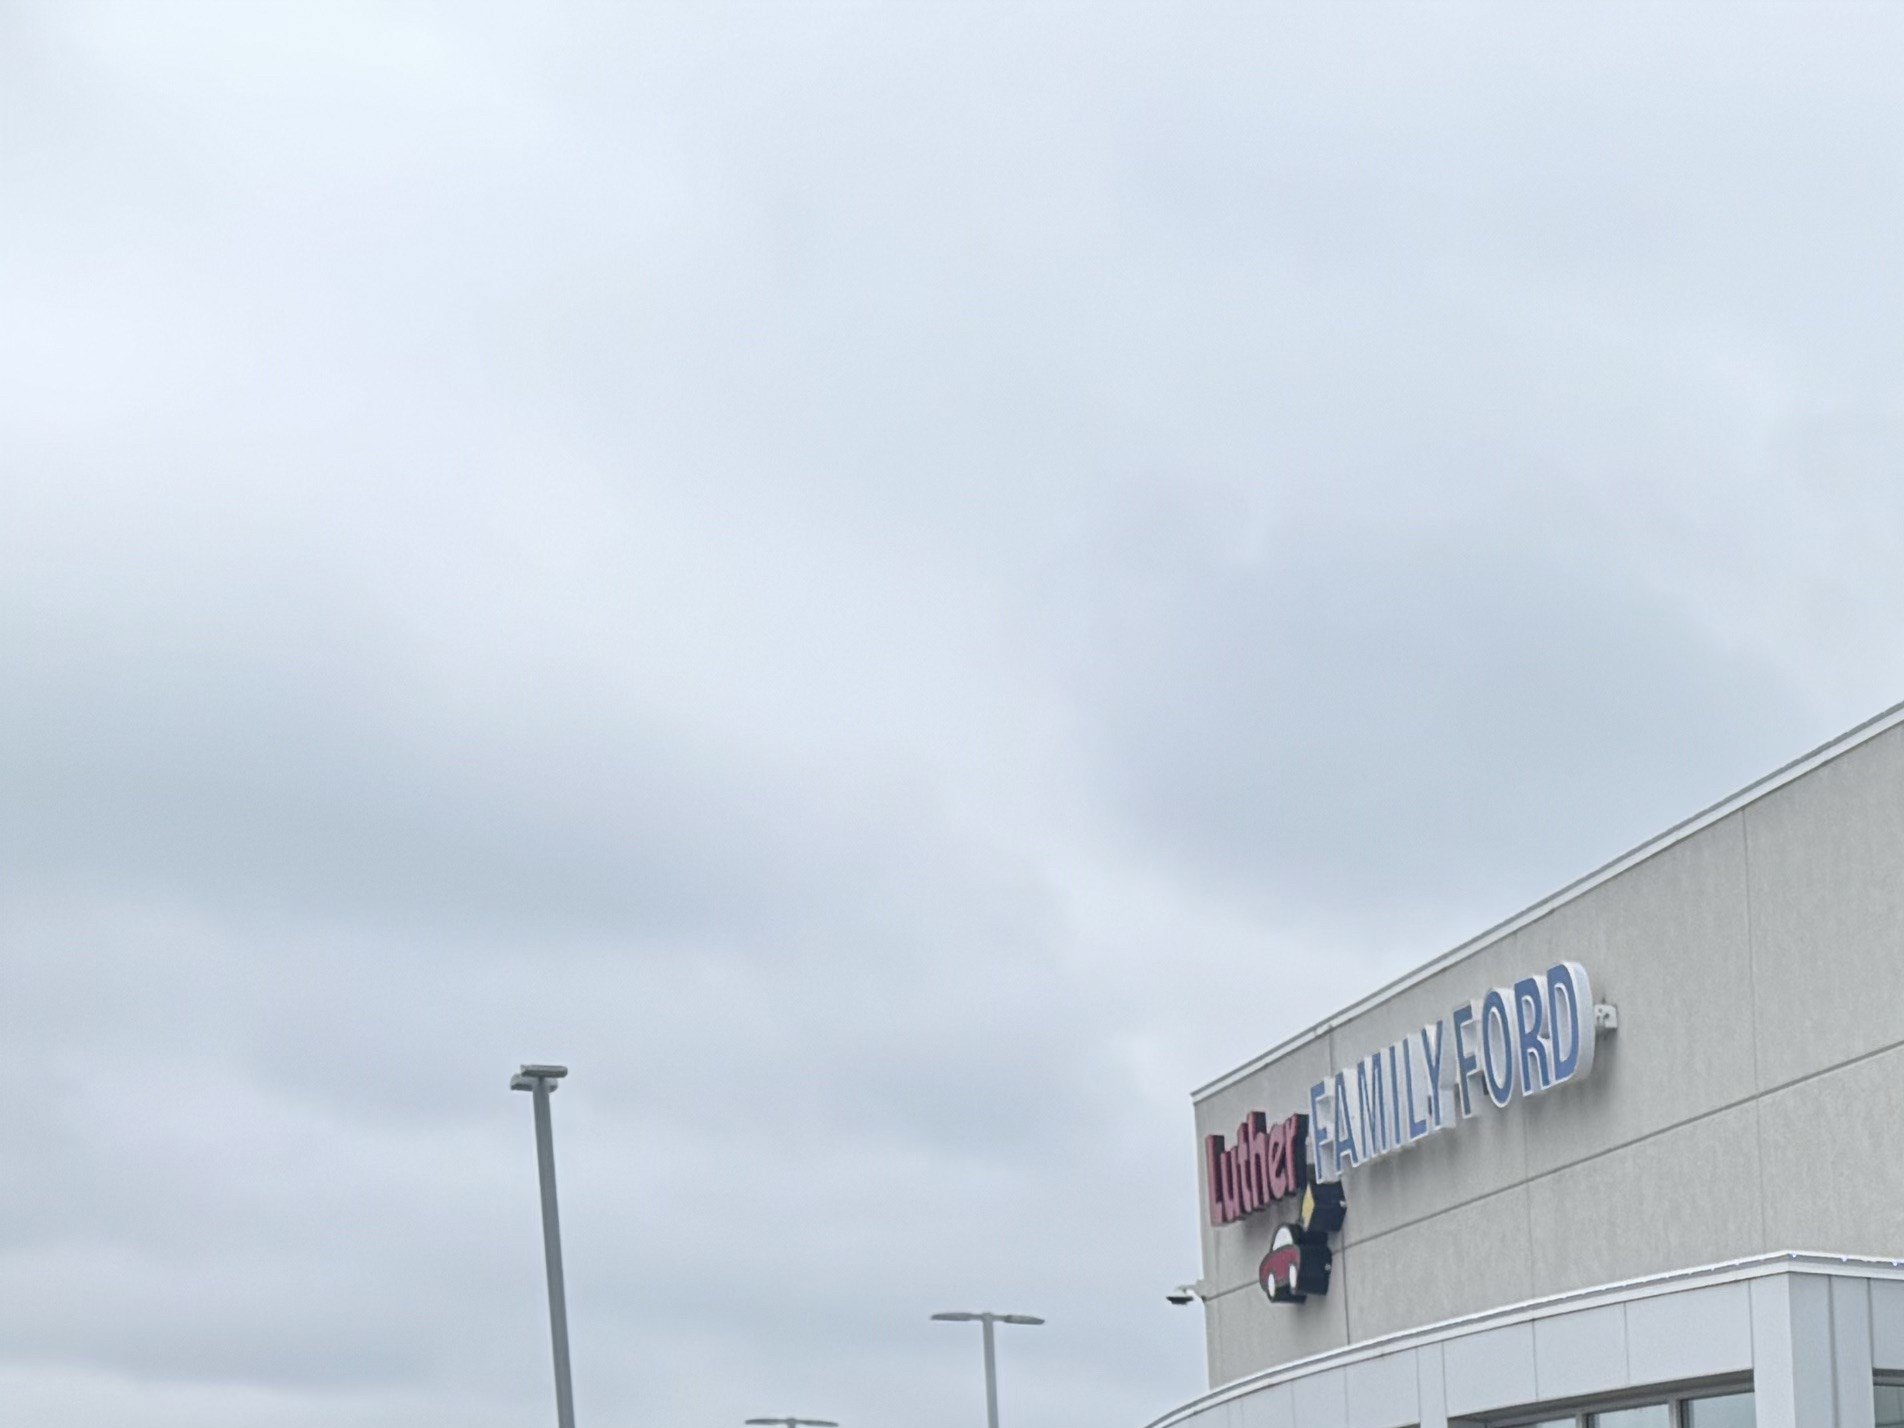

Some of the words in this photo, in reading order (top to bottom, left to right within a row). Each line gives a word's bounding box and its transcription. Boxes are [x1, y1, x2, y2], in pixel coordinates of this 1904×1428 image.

[1205, 1111, 1304, 1226] Luther
[1309, 1020, 1448, 1184] FAMILY
[1453, 962, 1587, 1118] FORD
